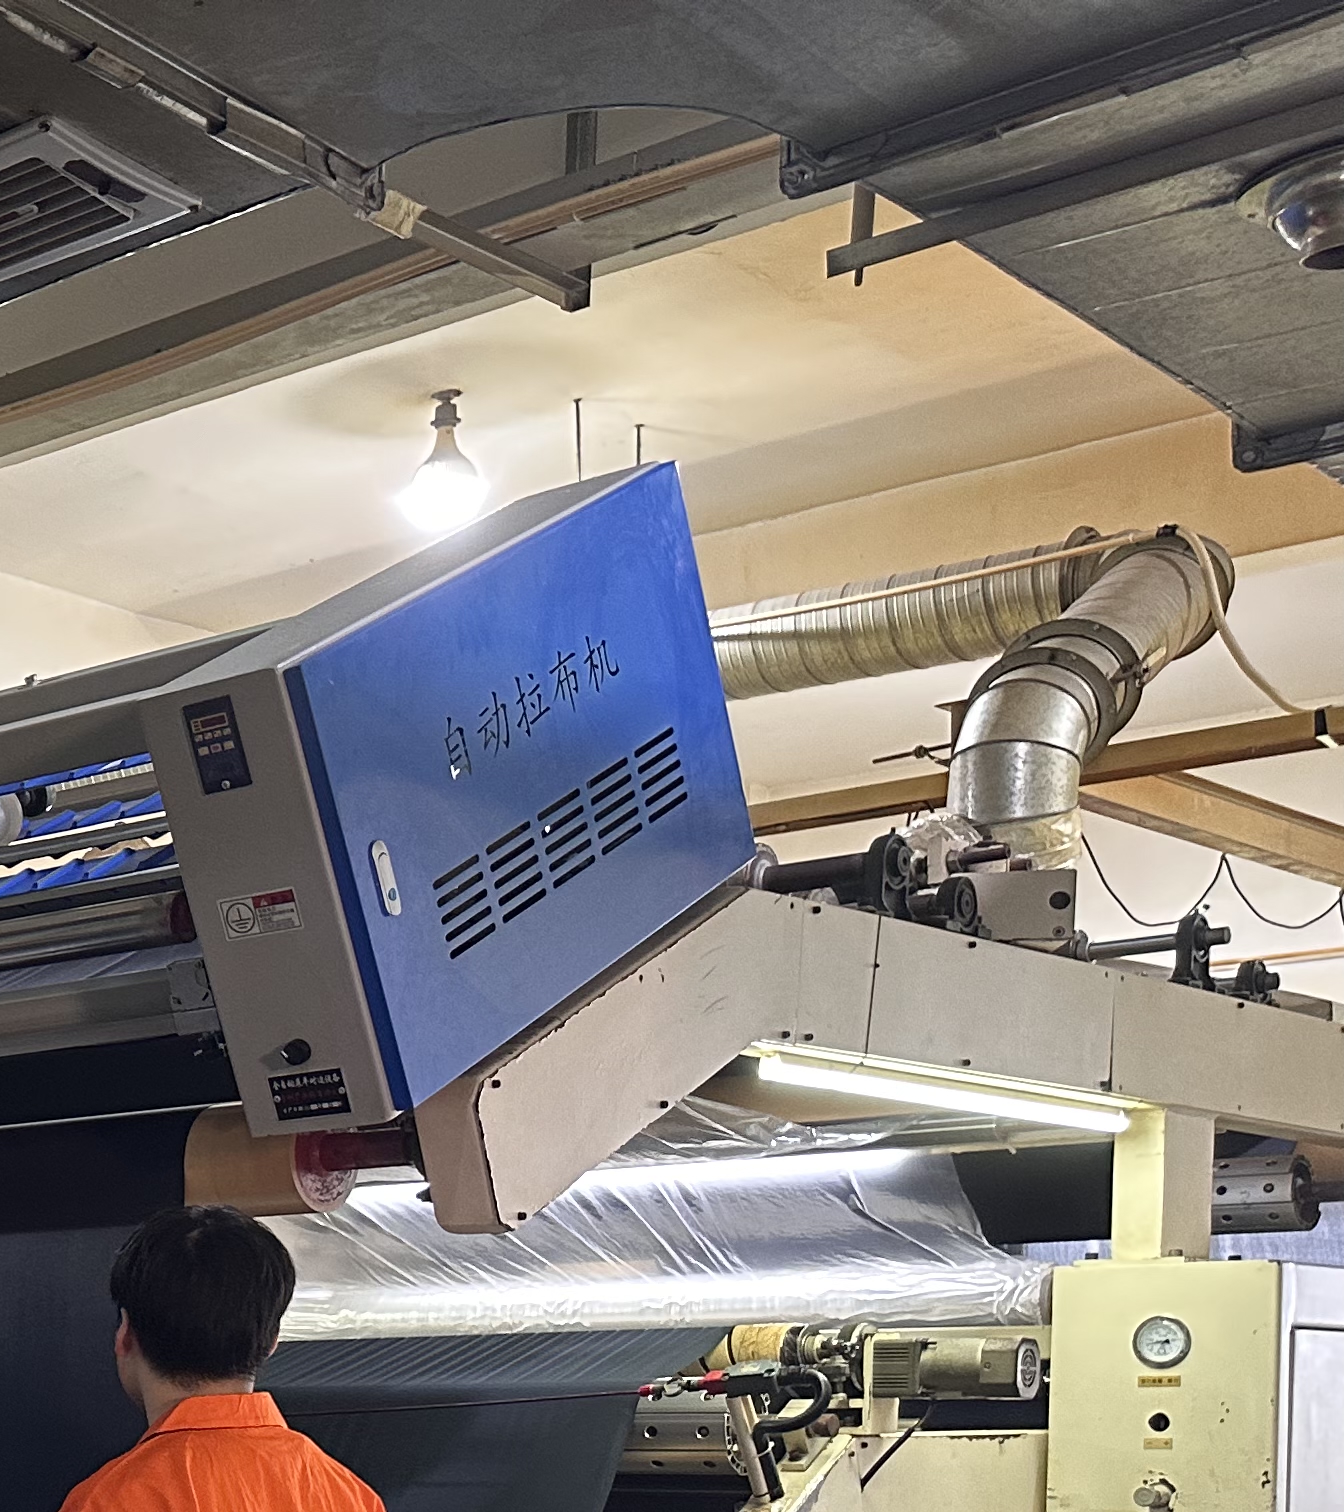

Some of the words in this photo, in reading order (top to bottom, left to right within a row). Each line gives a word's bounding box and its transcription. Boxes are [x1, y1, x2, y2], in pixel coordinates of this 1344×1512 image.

[443, 635, 621, 781] 自动拉布机
